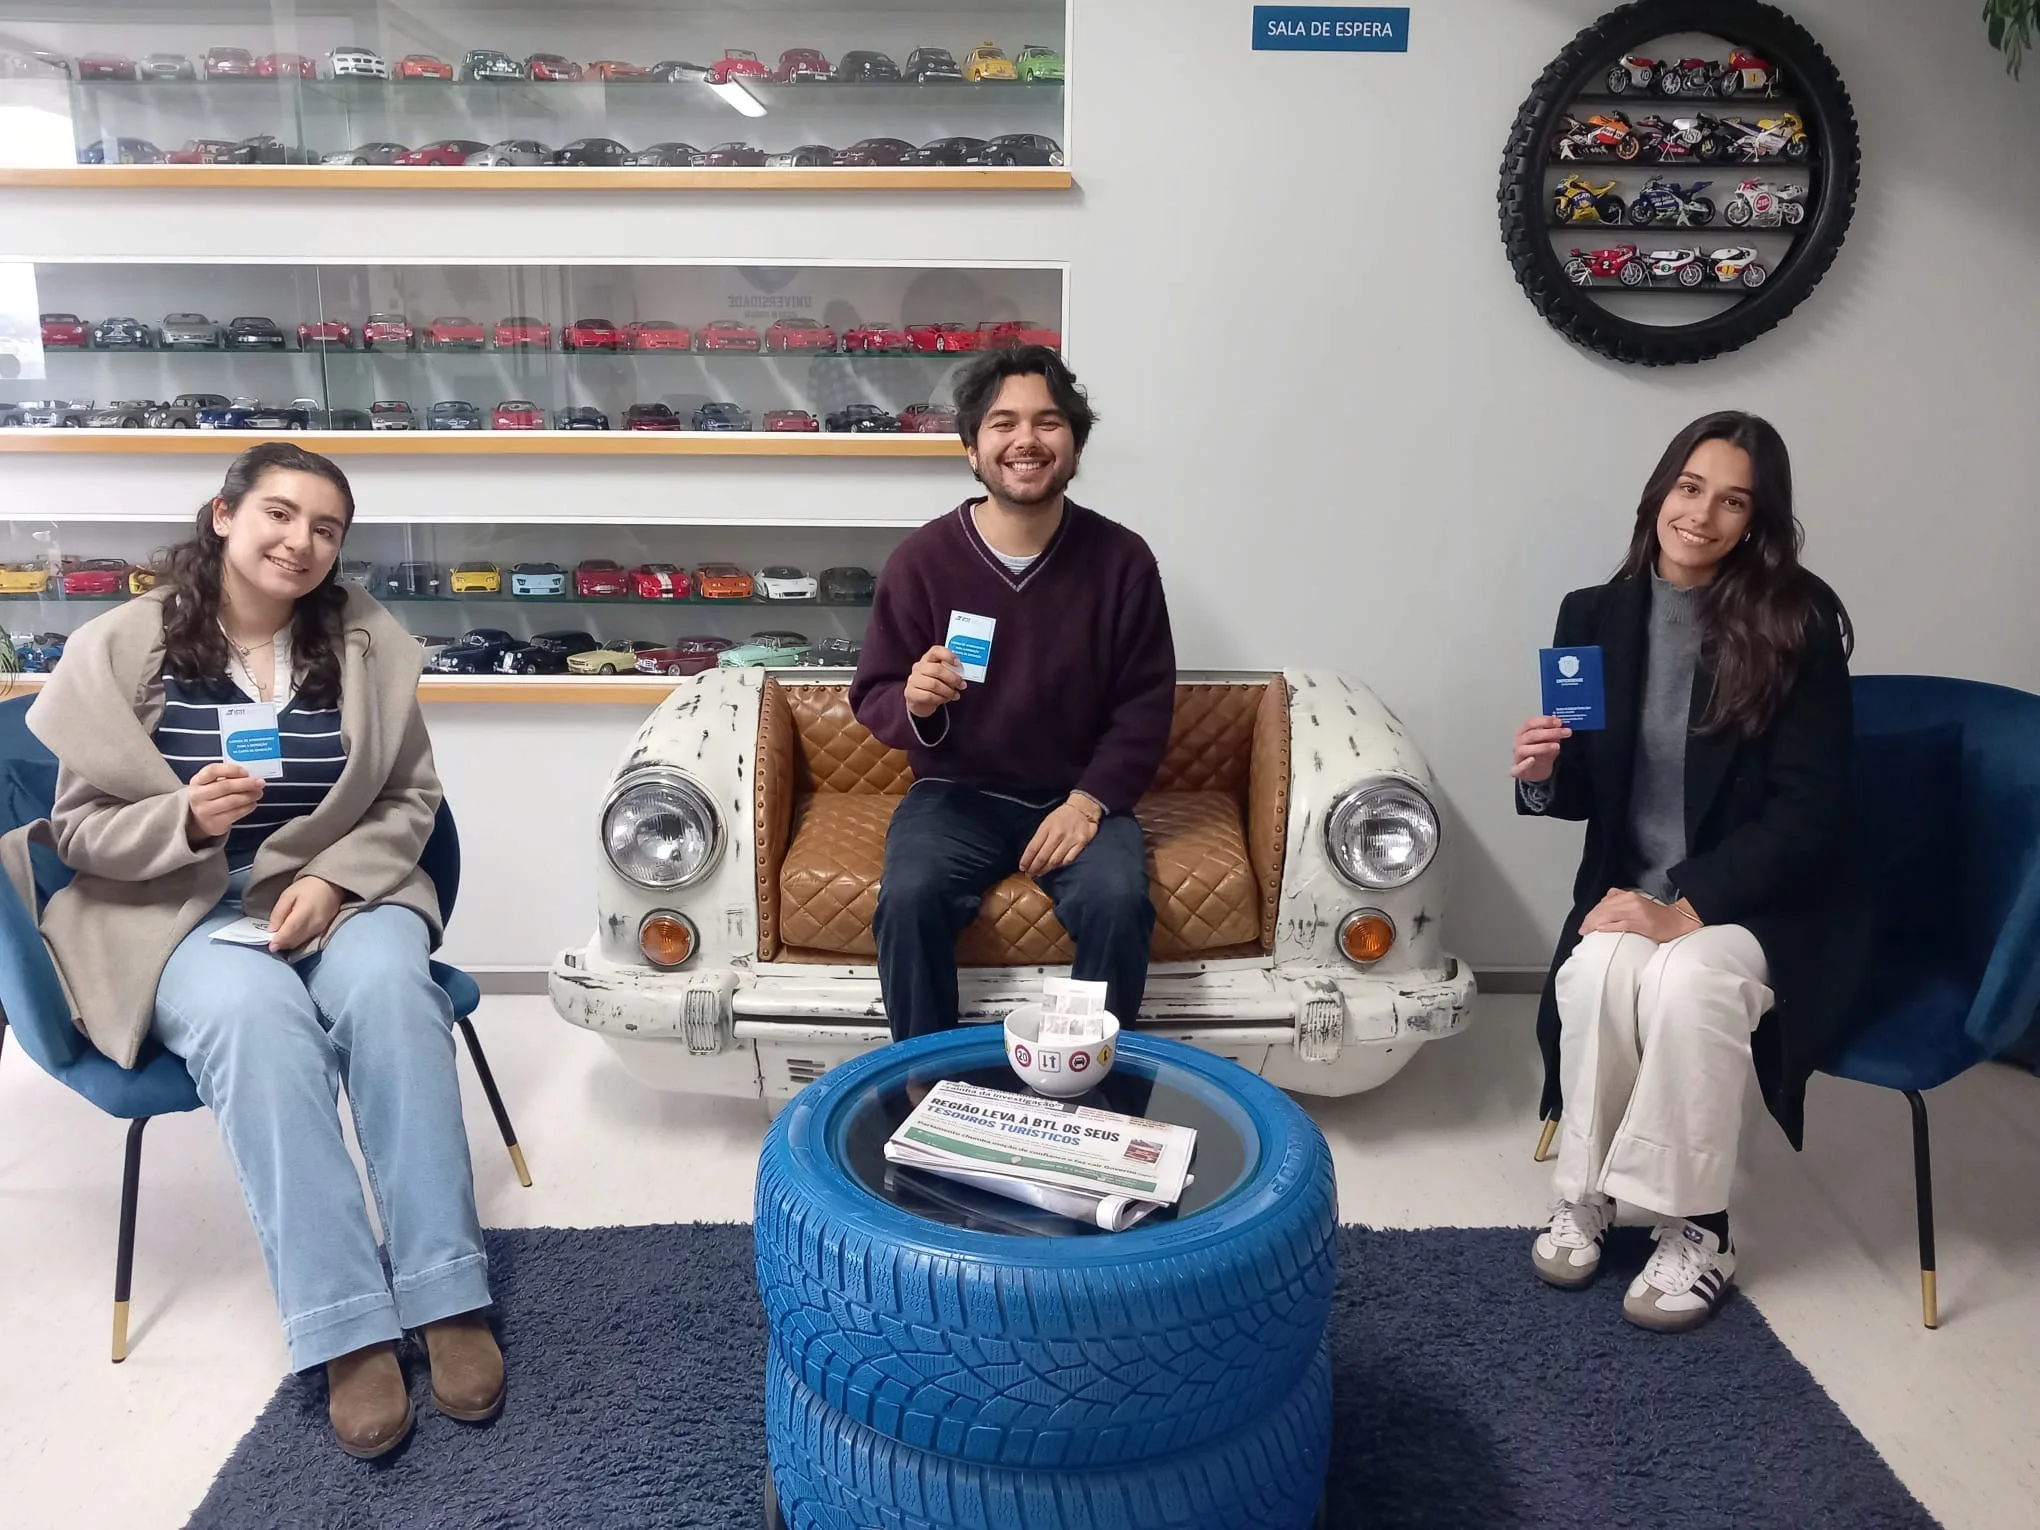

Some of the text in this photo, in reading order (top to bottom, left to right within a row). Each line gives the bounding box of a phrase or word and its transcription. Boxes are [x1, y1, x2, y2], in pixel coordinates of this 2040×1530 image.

[1267, 20, 1393, 37] SALA DE ESPERA
[1602, 260, 1610, 269] 2
[1018, 1051, 1027, 1062] 20
[927, 1105, 1081, 1146] TESOUROS TURÍSTICOS
[931, 1097, 980, 1114] REGIÃO
[981, 1108, 1016, 1123] LEVA
[1019, 1113, 1029, 1125] À
[1032, 1117, 1060, 1131] BTL
[1062, 1123, 1081, 1135] OS
[1083, 1128, 1120, 1142] SEUS
